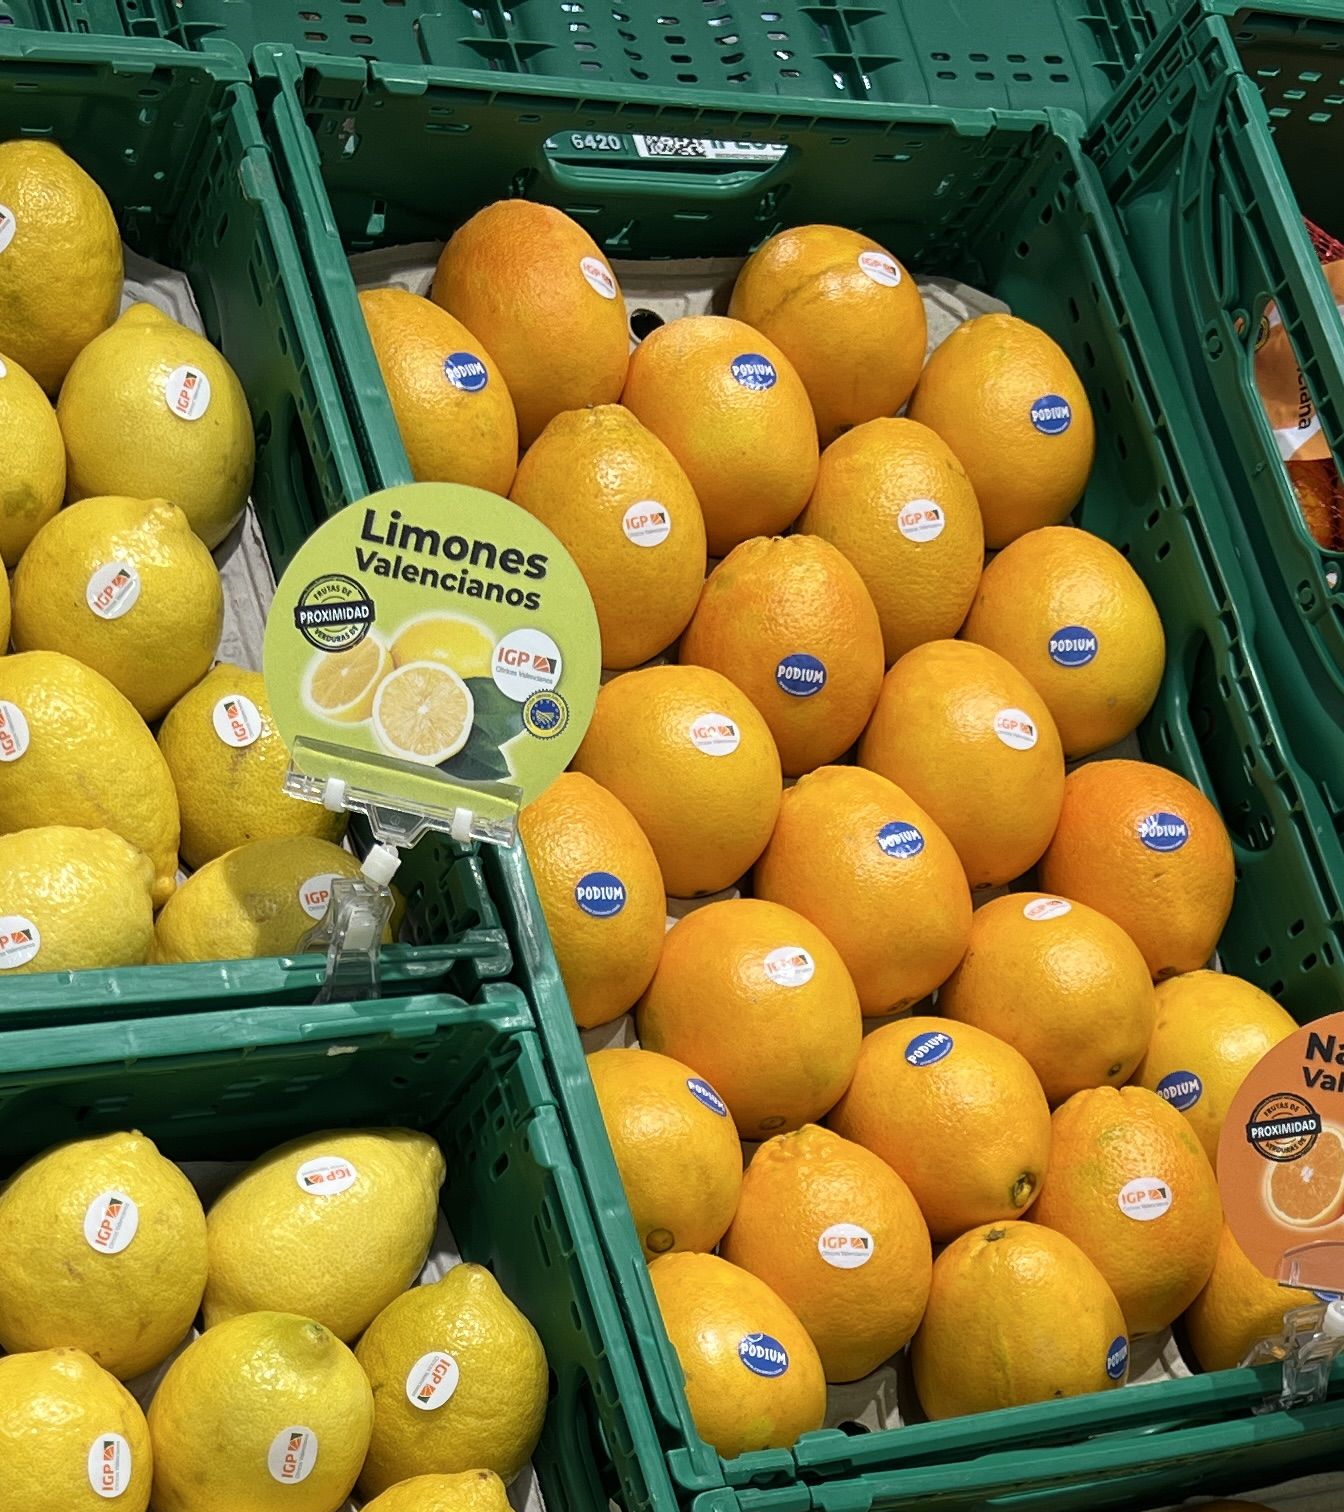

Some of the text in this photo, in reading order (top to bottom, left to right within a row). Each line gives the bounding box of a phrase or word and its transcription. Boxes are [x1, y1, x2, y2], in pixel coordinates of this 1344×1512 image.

[570, 134, 621, 150] 6420
[731, 364, 775, 380] PODIUM
[1031, 406, 1069, 422] PODIUM
[627, 516, 648, 529] IGP
[361, 509, 548, 580] Limones
[355, 547, 541, 611] Valencianos
[94, 585, 113, 608] IGP
[300, 606, 369, 624] PROXIMIDAD
[1049, 638, 1096, 655] PODIUM
[497, 647, 530, 667] IGP
[776, 665, 824, 684] PODIUM
[879, 829, 921, 850] PODIUM
[1140, 825, 1186, 840] PODIUM
[575, 886, 624, 901] PODIUM
[907, 1032, 948, 1065] PODIUM
[1251, 1119, 1316, 1139] PROXIMIDAD
[1122, 1191, 1146, 1204] IGP
[95, 1219, 114, 1248] IGP
[739, 1342, 788, 1366] PODIUM
[432, 1360, 451, 1385] IGP
[282, 1454, 297, 1478] IGP
[102, 1465, 115, 1493] IGP
